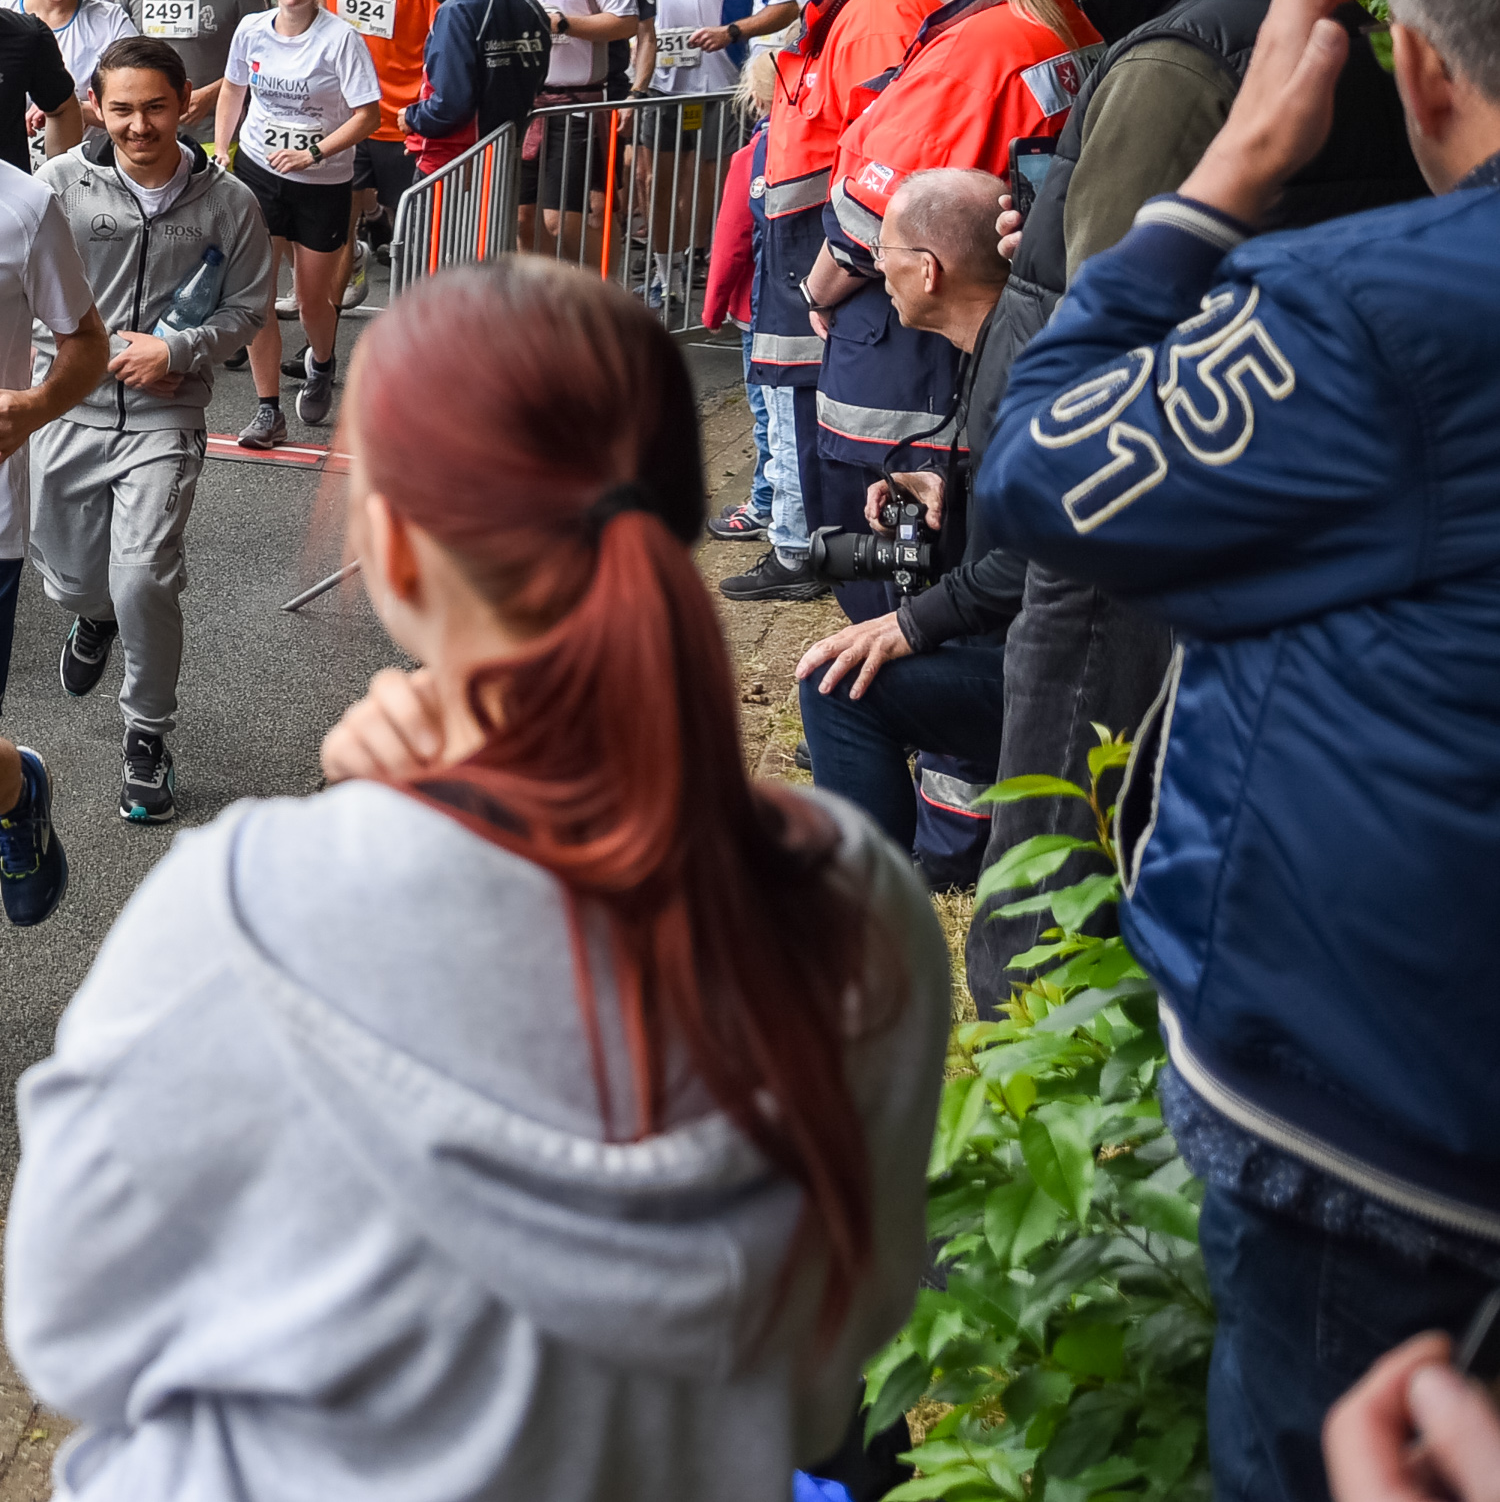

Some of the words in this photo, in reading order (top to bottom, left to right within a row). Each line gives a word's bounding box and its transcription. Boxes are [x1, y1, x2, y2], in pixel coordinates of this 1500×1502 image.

[145, 2, 194, 20] 2491
[257, 88, 311, 102] OLDENBURG
[164, 224, 203, 238] BOSS
